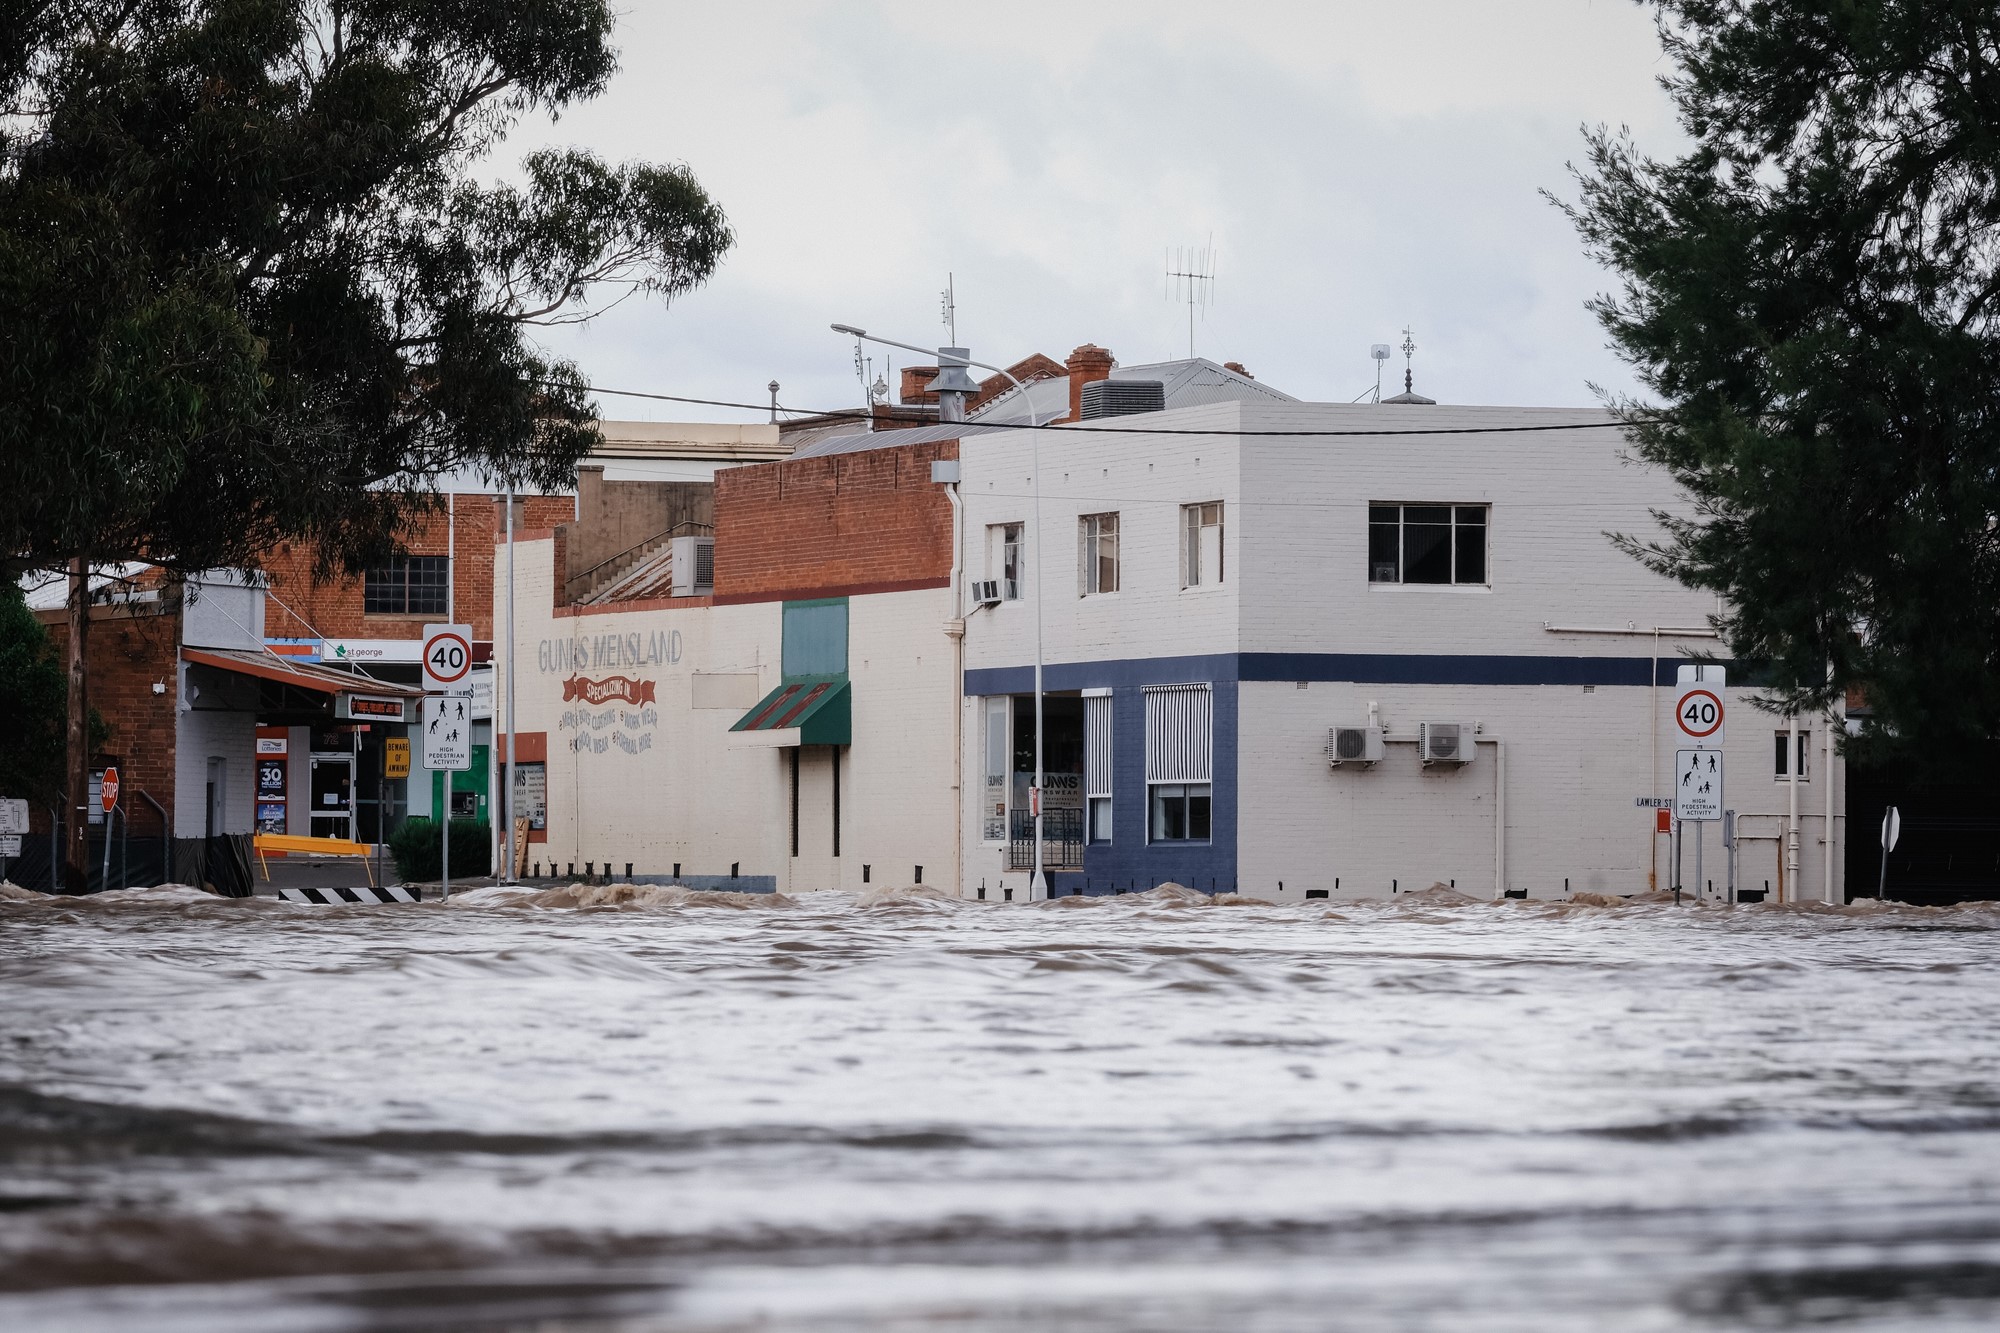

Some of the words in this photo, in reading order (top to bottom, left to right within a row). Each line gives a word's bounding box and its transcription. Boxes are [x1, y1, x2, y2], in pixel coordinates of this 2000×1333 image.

[346, 648, 383, 657] st.george
[431, 647, 464, 669] 40
[594, 629, 683, 669] MENSLAND
[586, 680, 624, 701] SPECIALIZING
[624, 682, 633, 700] IN
[641, 708, 657, 729] WEAR
[1684, 704, 1715, 723] 40
[388, 743, 408, 751] BEWARE
[593, 735, 609, 754] WEAR
[616, 730, 638, 755] FORMAL
[639, 732, 652, 754] HIRE
[395, 754, 401, 762] OF
[388, 764, 407, 772] AWNING
[103, 782, 118, 799] STOP
[1636, 798, 1662, 807] LAWLER
[1664, 799, 1673, 808] ST
